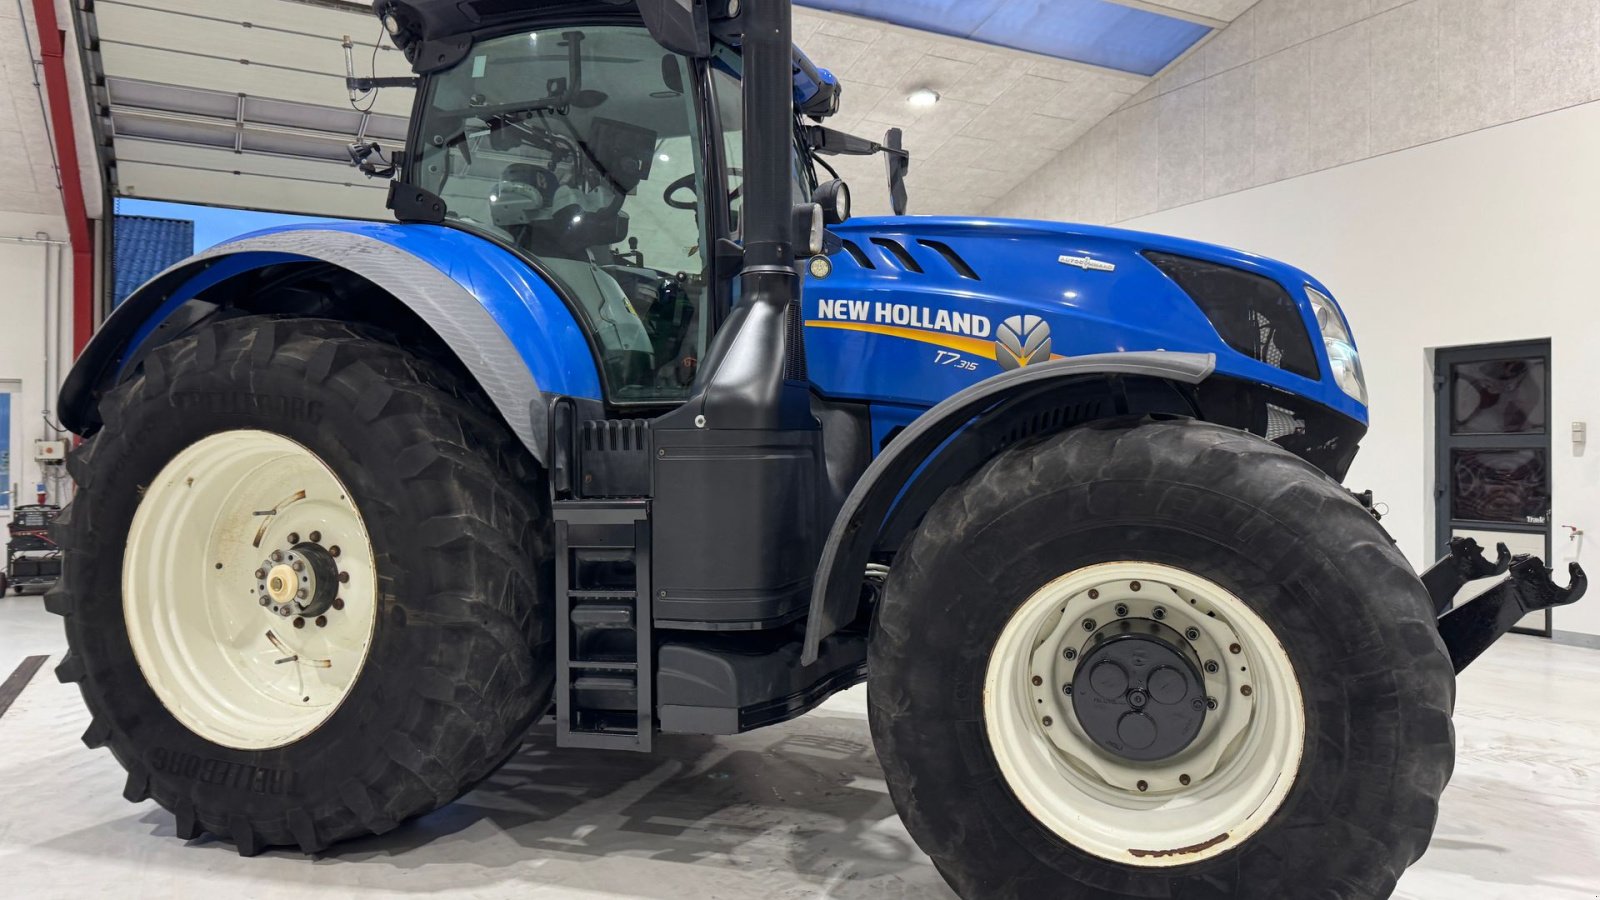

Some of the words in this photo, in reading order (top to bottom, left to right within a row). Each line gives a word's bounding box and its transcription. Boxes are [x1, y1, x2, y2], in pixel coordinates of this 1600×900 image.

[818, 299, 870, 321] NEW
[875, 302, 991, 338] HOLLAND
[933, 350, 979, 371] T7.315
[151, 747, 305, 799] TRELLEBORG
